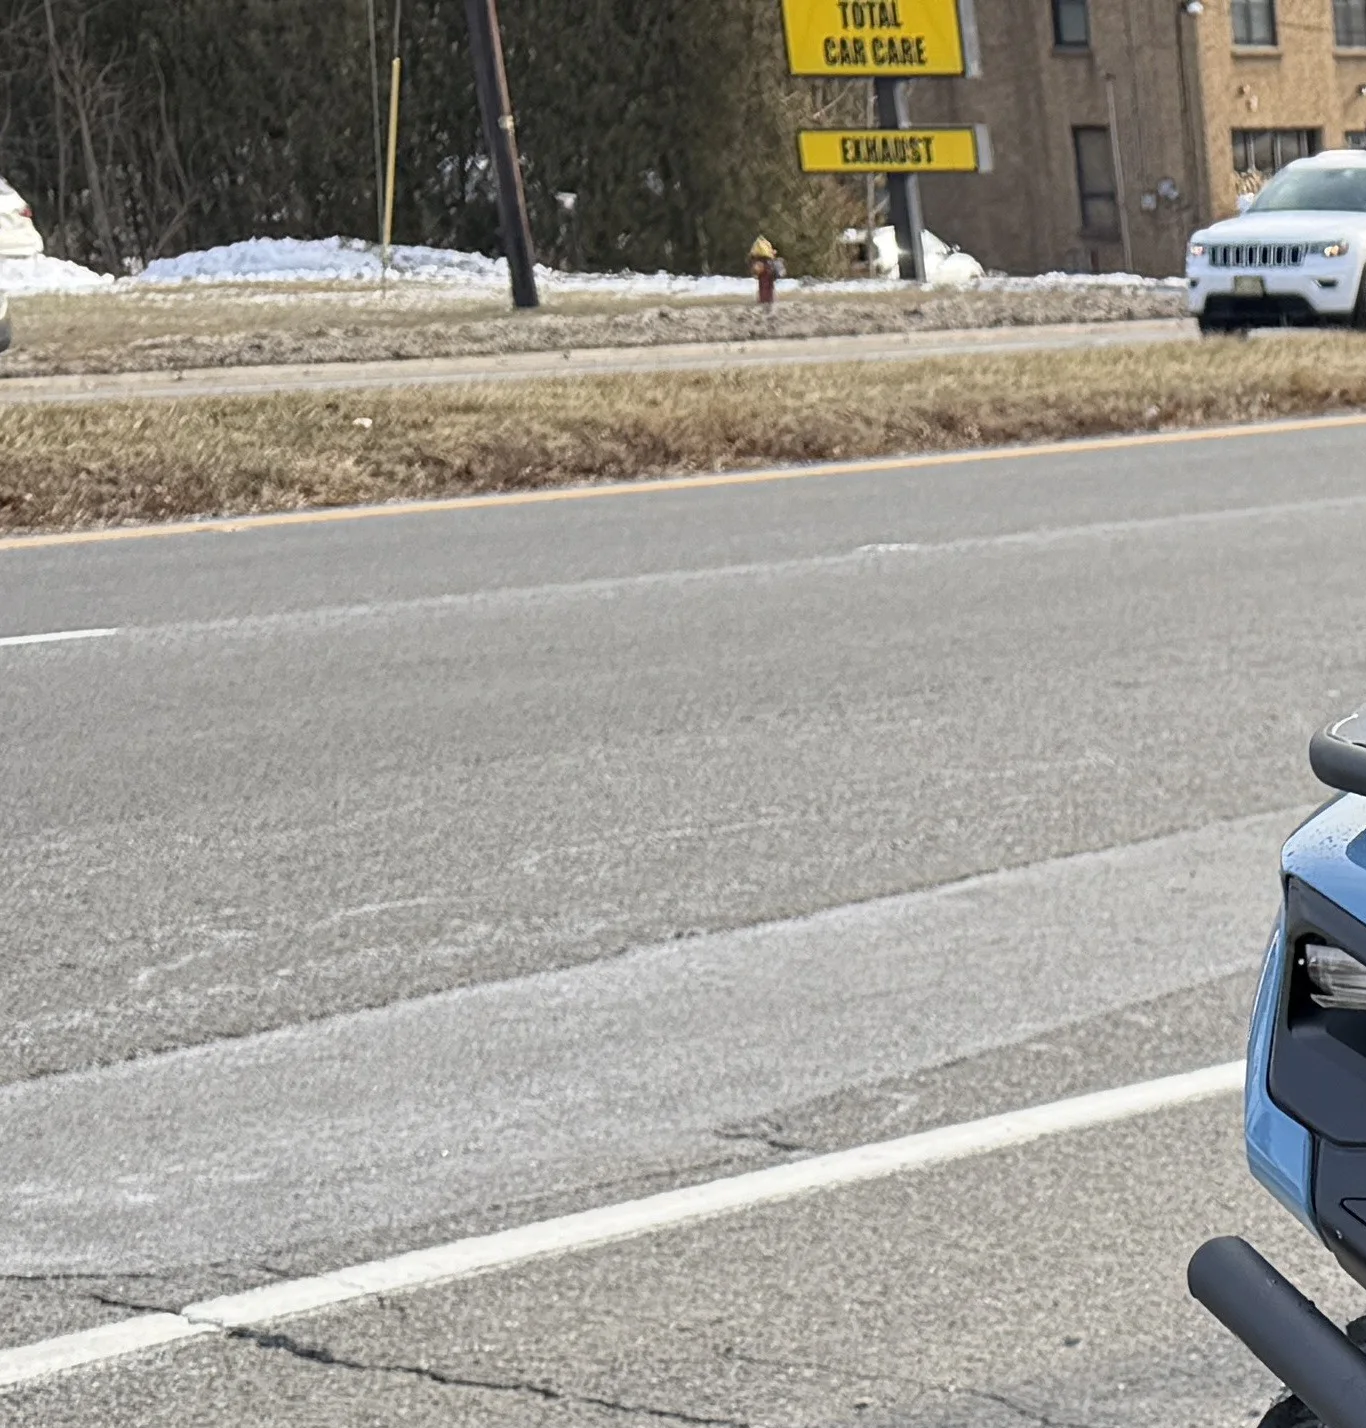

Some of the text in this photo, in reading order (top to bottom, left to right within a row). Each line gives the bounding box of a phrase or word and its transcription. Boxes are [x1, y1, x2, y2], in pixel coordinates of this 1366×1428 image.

[838, 1, 902, 28] TOTAL
[824, 36, 927, 66] CAR CARE
[841, 136, 935, 165] EXHAUST
